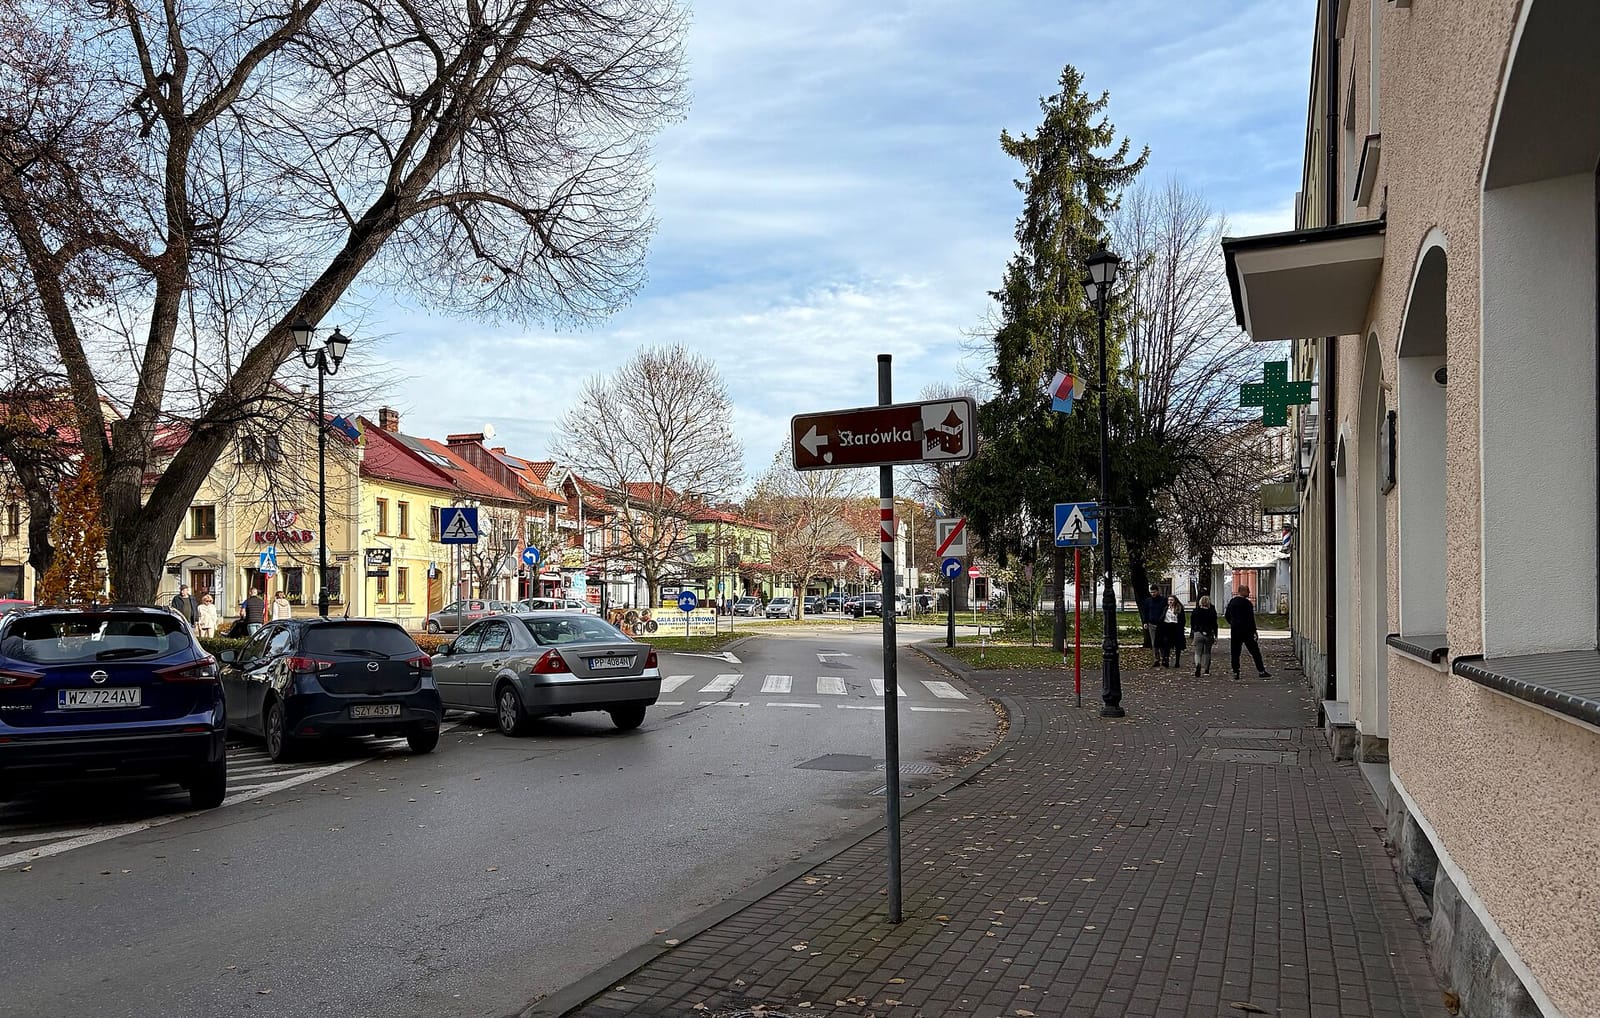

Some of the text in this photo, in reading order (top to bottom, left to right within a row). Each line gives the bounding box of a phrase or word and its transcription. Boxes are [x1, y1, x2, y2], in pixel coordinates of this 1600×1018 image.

[840, 426, 912, 447] Starówka
[595, 658, 604, 667] PP
[69, 690, 137, 704] WZ 724AV
[355, 704, 400, 716] SZY 43517
